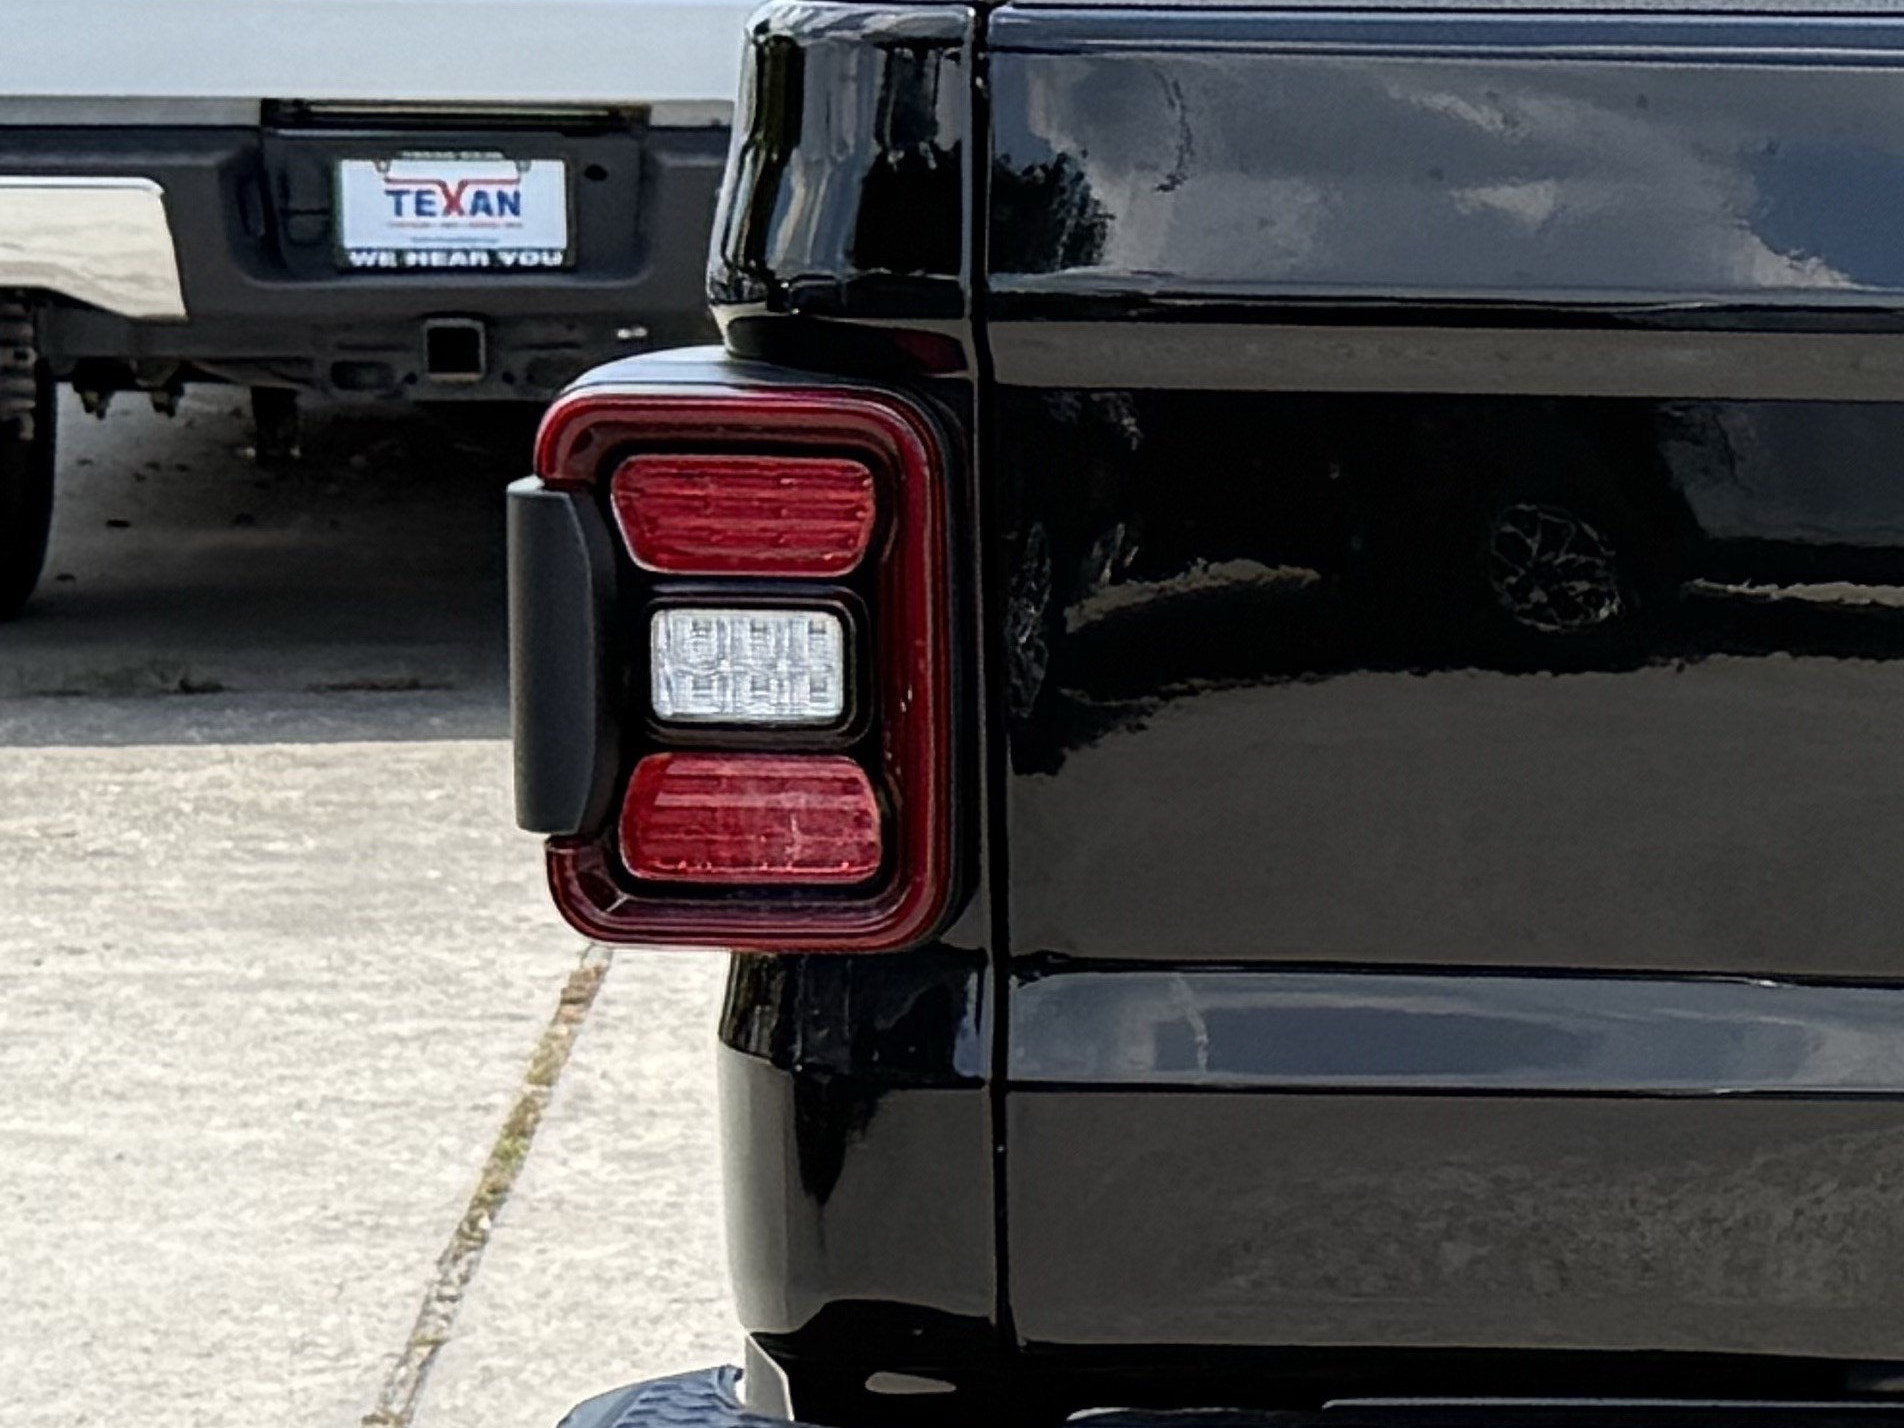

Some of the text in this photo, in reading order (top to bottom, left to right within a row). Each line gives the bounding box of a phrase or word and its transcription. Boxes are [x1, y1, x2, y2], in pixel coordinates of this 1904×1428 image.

[385, 180, 522, 218] TEXAN
[349, 251, 564, 267] WE HEAR YOU
